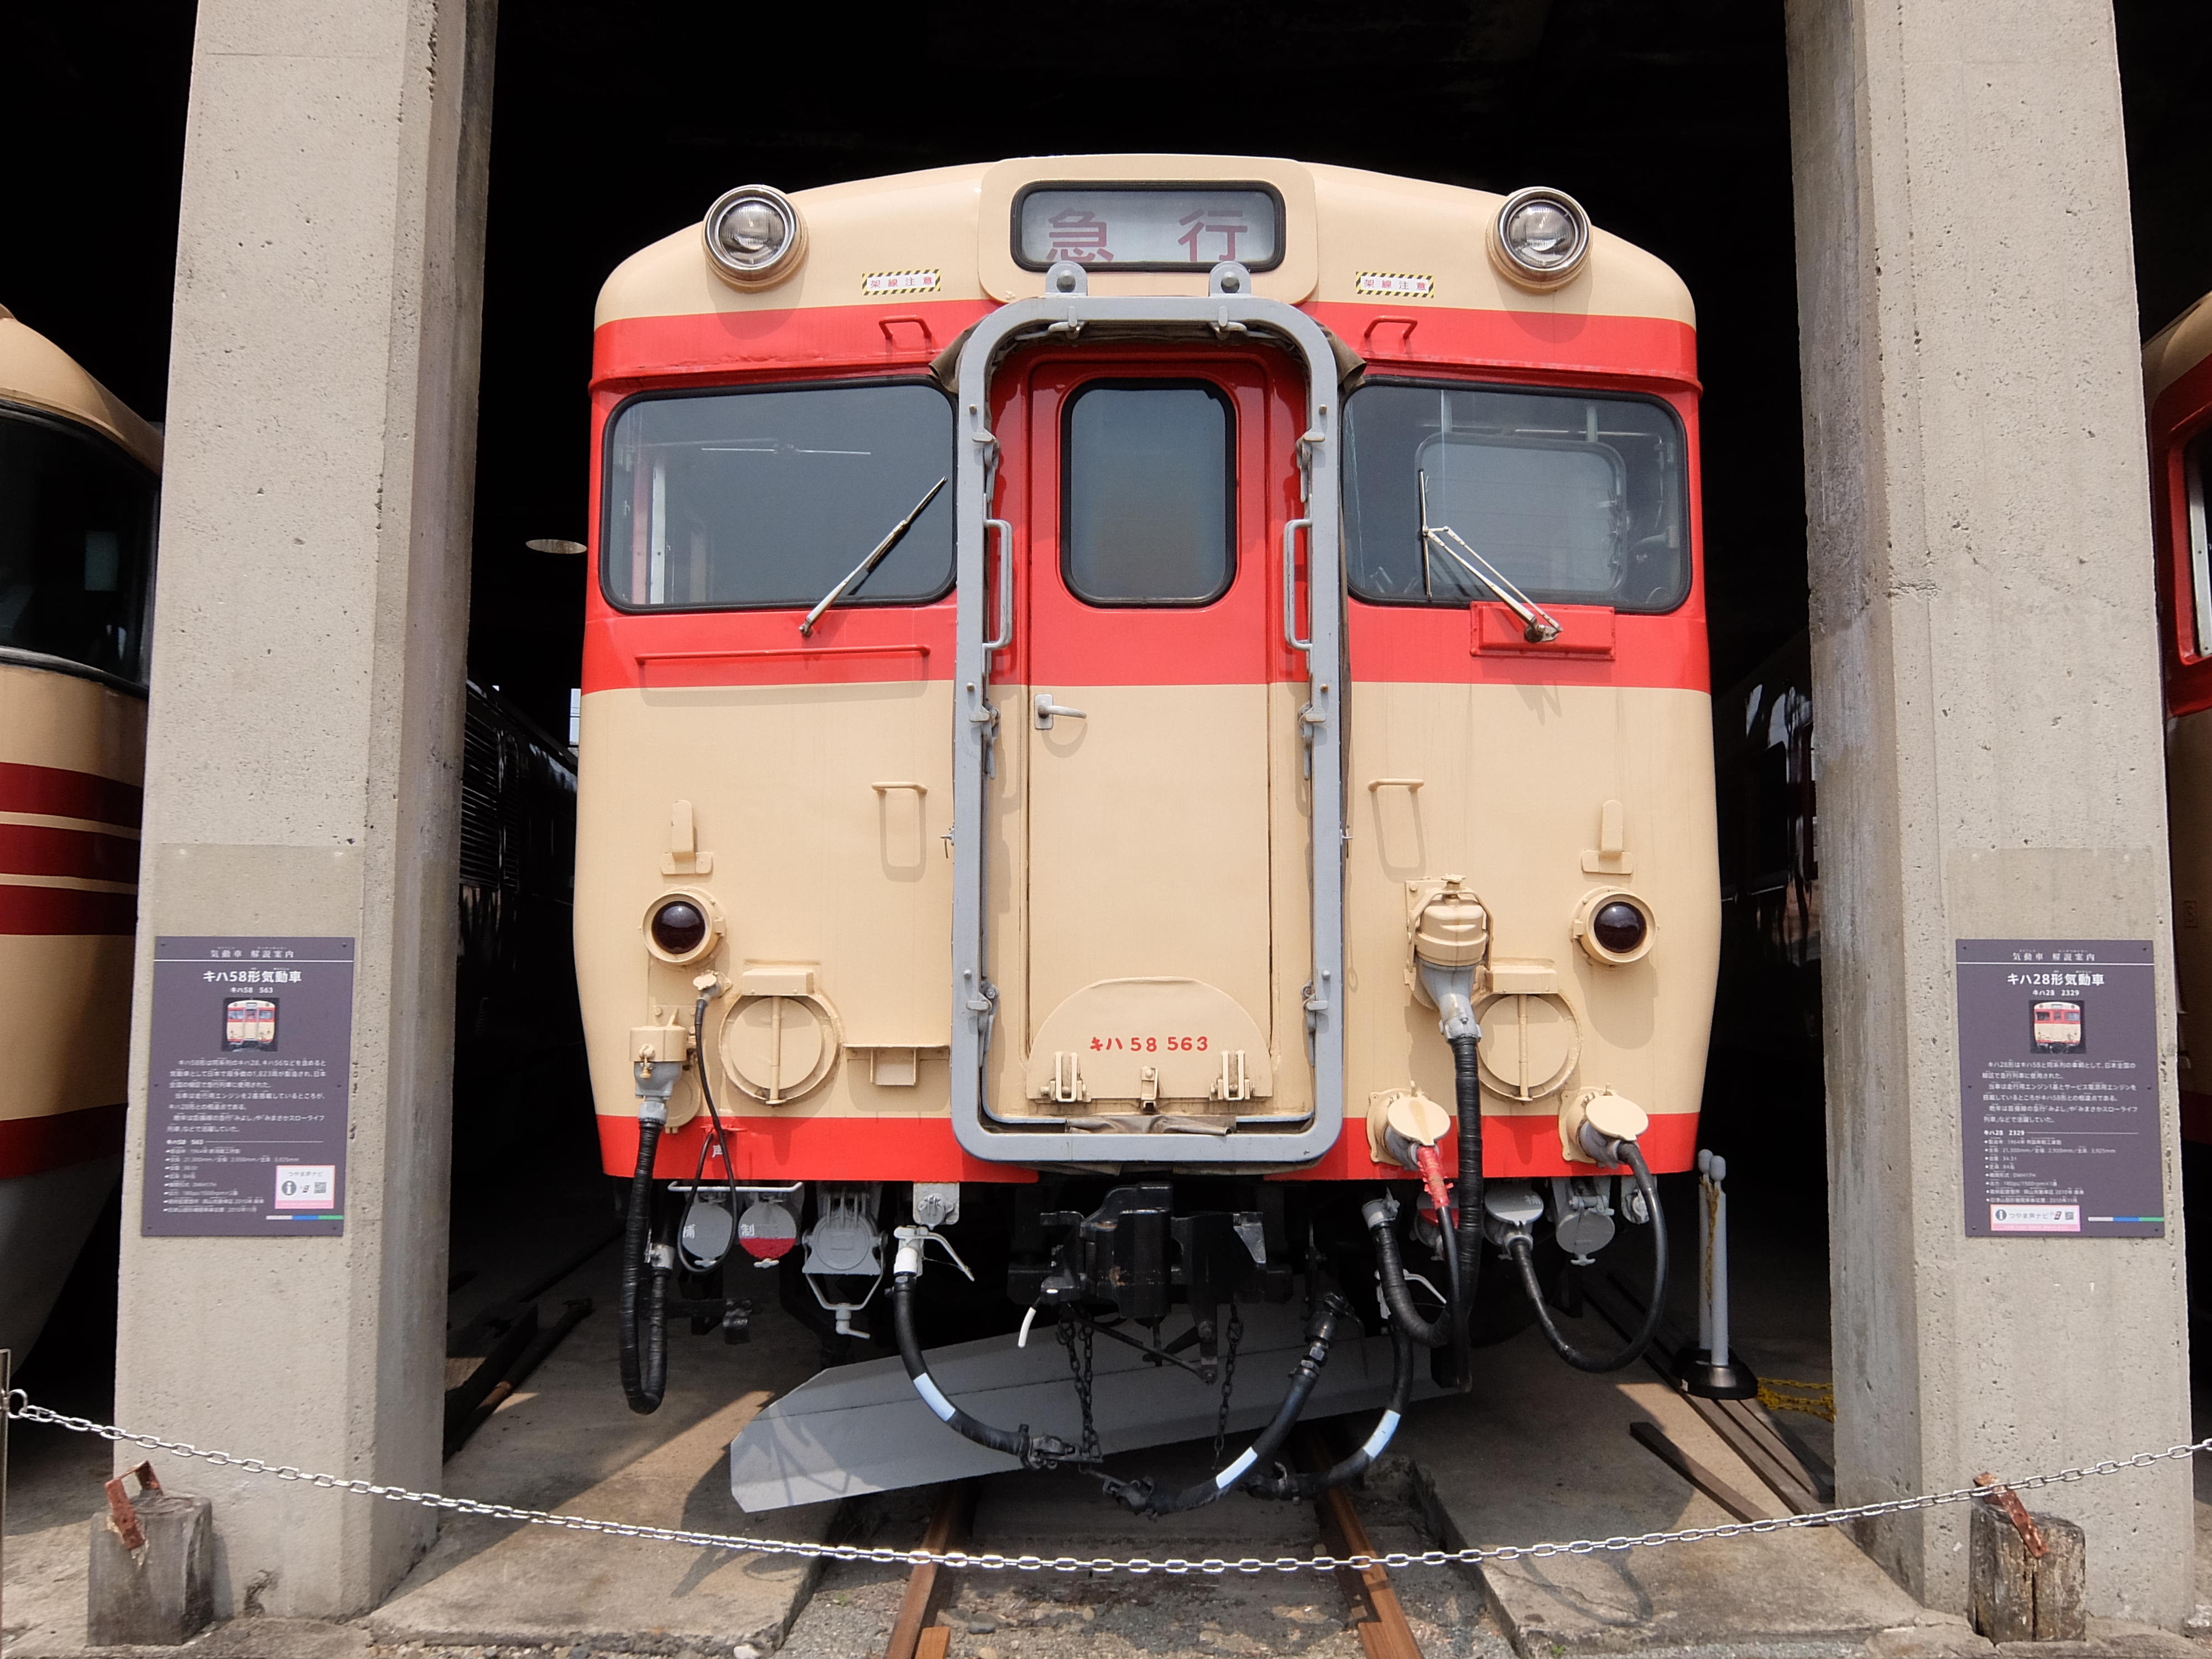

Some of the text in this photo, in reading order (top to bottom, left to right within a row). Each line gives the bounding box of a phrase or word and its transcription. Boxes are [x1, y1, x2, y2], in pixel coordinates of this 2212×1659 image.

[1046, 207, 1248, 262] 急行
[870, 276, 932, 288] 架線注意
[1364, 279, 1426, 291] 架線注意
[211, 950, 294, 958] 気動車 解説案内
[2012, 952, 2095, 961] 気動車 解説案内
[203, 971, 302, 983] キハ58形気動車
[2007, 973, 2105, 986] キハ28形気動車
[1167, 1036, 1208, 1051] 563
[740, 1223, 755, 1237] 制
